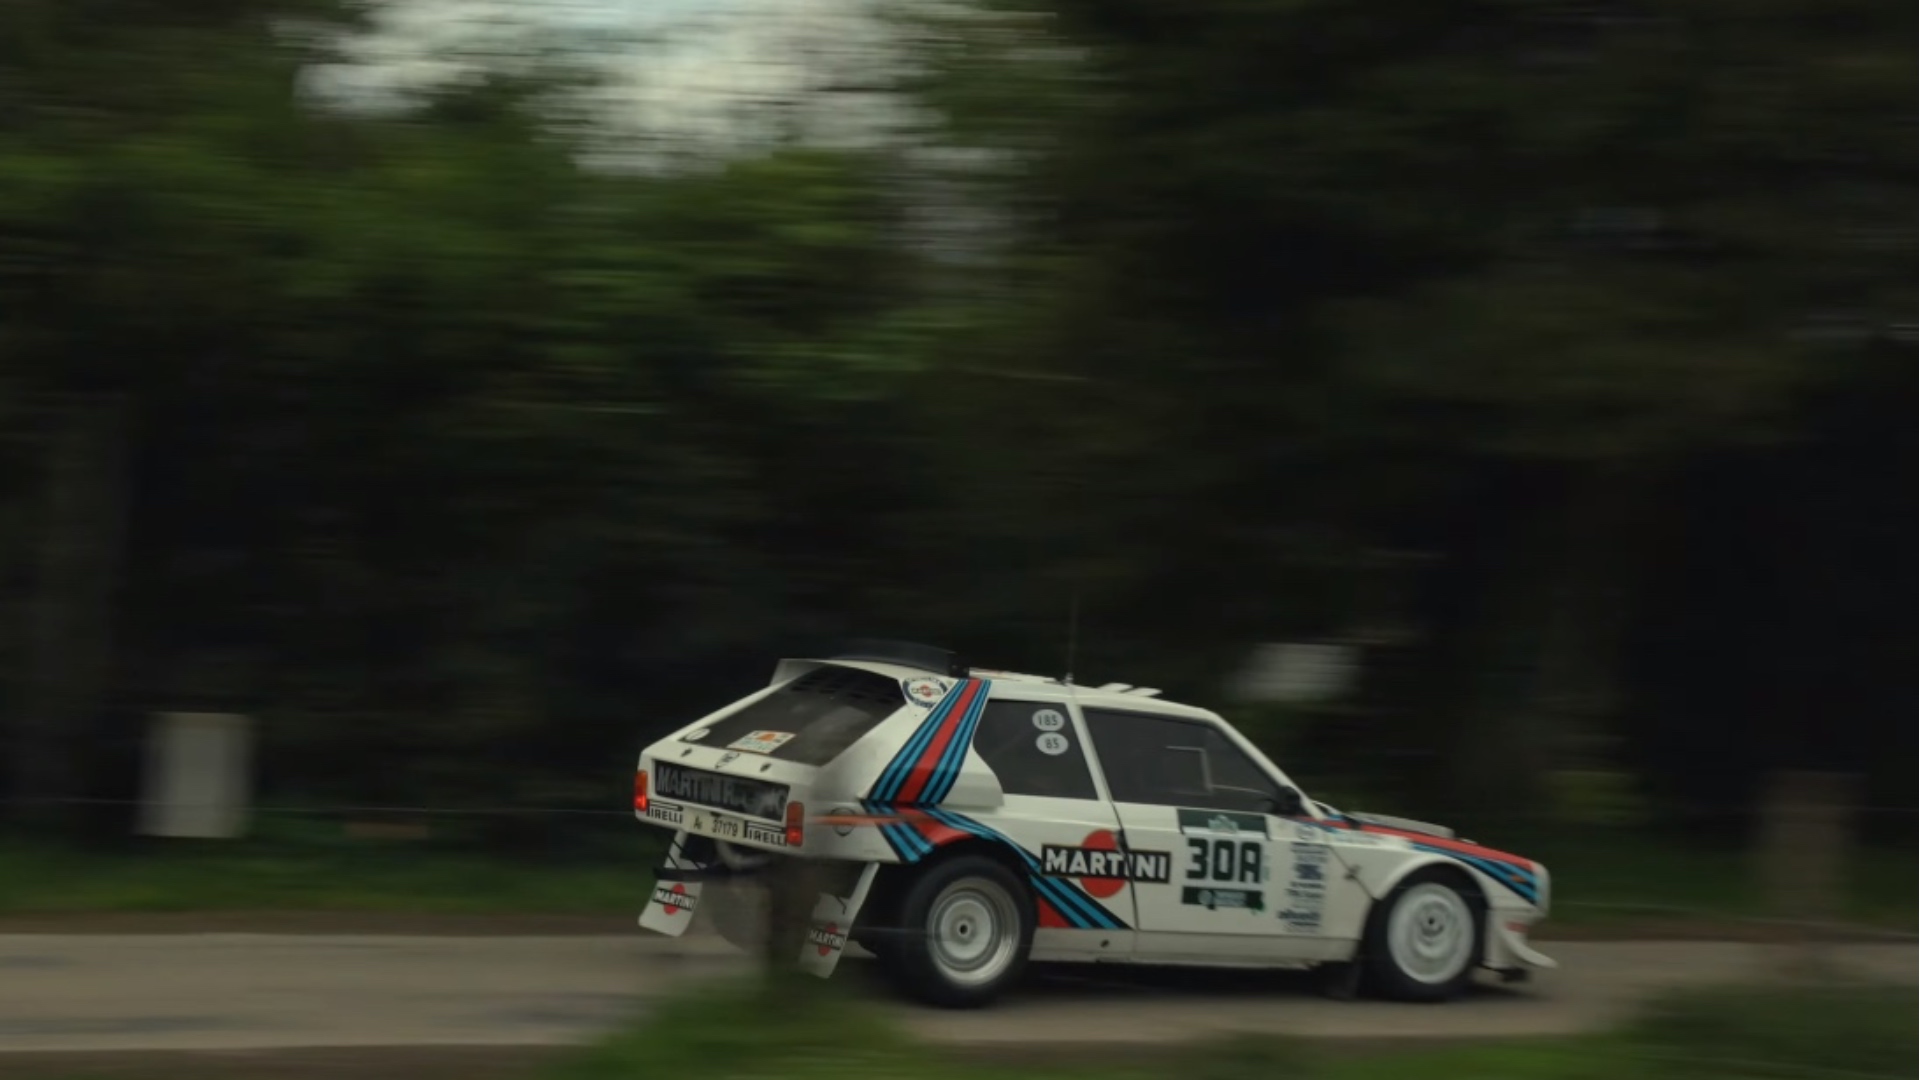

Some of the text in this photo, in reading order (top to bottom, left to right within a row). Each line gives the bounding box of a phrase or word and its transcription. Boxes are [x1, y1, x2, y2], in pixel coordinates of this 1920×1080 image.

[1038, 714, 1058, 727] 185
[1045, 738, 1060, 750] 85
[1045, 848, 1167, 879] MARTINI
[1185, 837, 1262, 884] 30A
[655, 889, 696, 911] MARTINI
[809, 930, 847, 948] MARTINI
